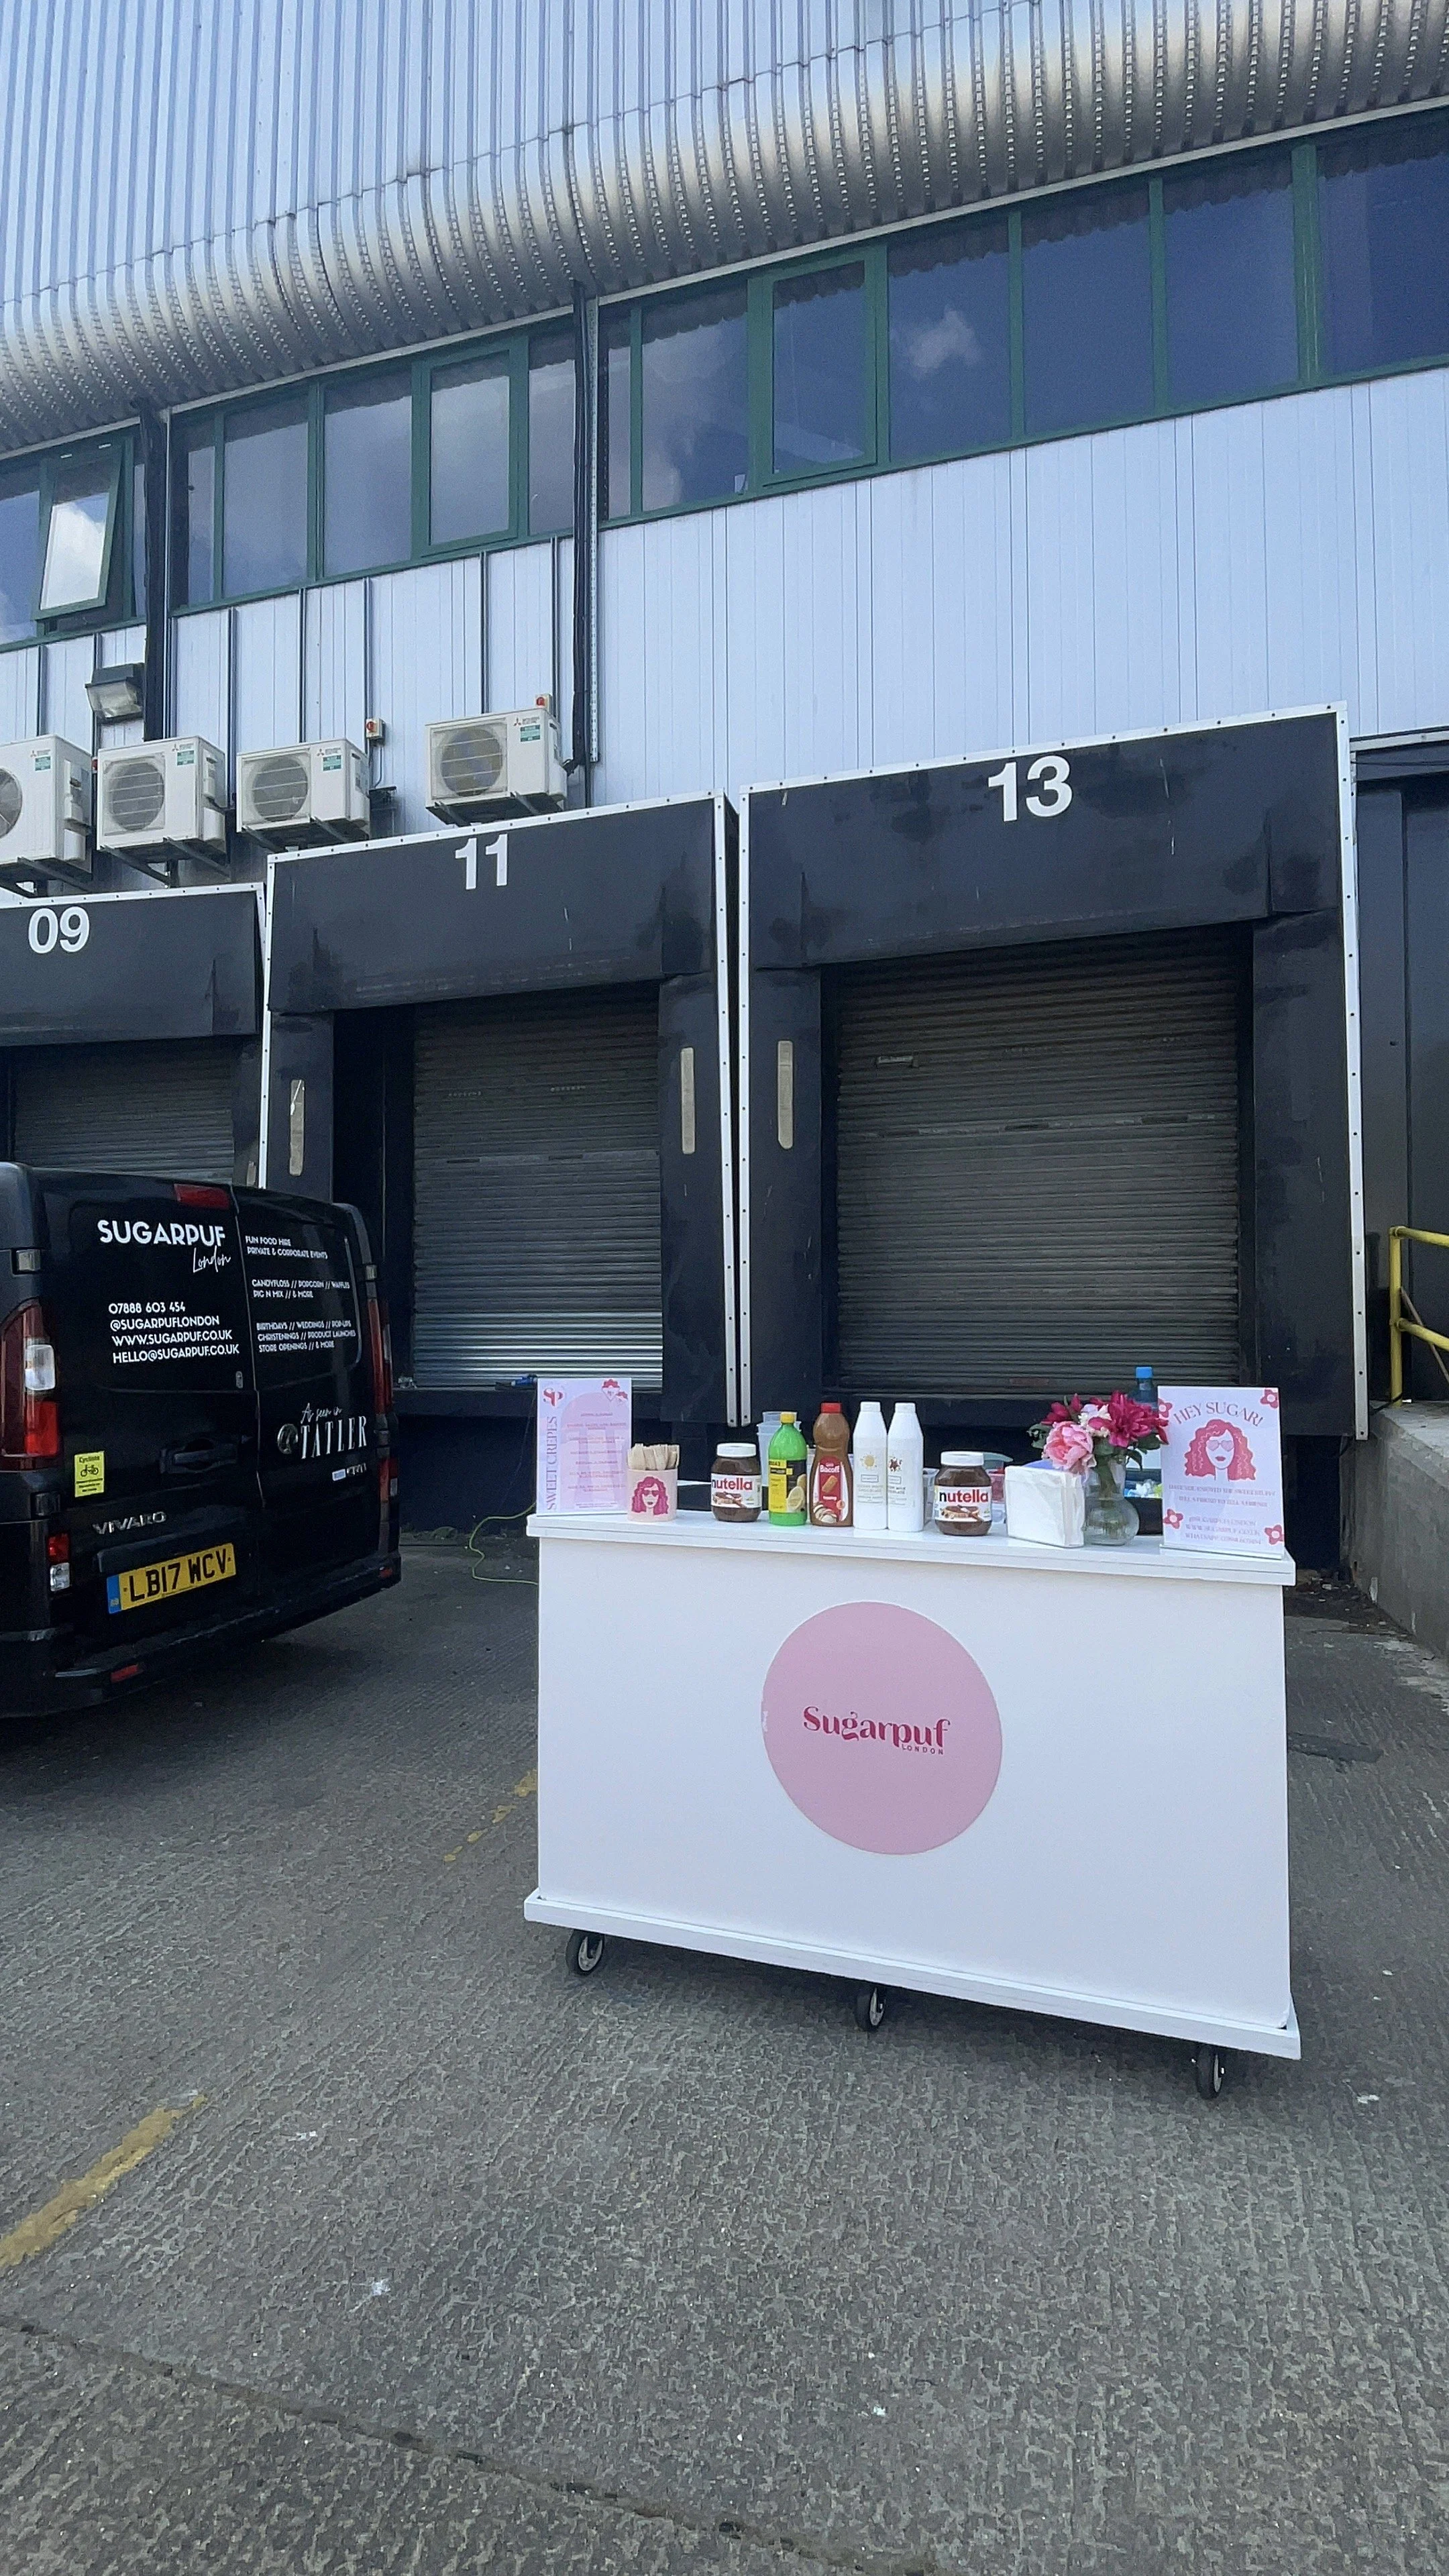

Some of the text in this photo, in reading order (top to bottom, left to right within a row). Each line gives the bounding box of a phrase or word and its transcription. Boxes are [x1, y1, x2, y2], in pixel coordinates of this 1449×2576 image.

[987, 755, 1073, 822] 13
[455, 833, 508, 890] 11
[28, 906, 89, 953] 09
[97, 1220, 225, 1247] SUGARPUF
[245, 1235, 259, 1244] FUN
[260, 1236, 277, 1245] FOOD
[193, 1245, 231, 1273] London
[247, 1246, 270, 1256] PRIVATE
[277, 1248, 309, 1258] CORPORATE
[310, 1250, 328, 1259] EVENTS
[252, 1279, 290, 1288] CANDYFLOSS
[298, 1280, 324, 1289] POPCORN
[266, 1290, 272, 1298] N
[272, 1290, 284, 1298] MIX
[298, 1291, 313, 1299] MORE
[108, 1301, 186, 1315] 07888 603 454
[110, 1316, 220, 1332] @SUGARPUFLONDON
[256, 1322, 288, 1331] BIRTHDAYS
[296, 1321, 325, 1329] WEDDINGS
[111, 1330, 233, 1347] WWW.SUGARPUF.CO.UK
[258, 1332, 299, 1342] CHRISTENINGS
[307, 1330, 332, 1339] PRODUCT
[332, 1330, 356, 1338] LAUNCHES
[113, 1344, 240, 1364] HELLO@SUGARPUF.CO.UK
[258, 1344, 277, 1352] STORE
[278, 1342, 307, 1351] OPENINGS
[320, 1340, 335, 1348] MORE
[1173, 1401, 1264, 1427] HEY SUGAR!
[301, 1415, 367, 1459] TATLER
[546, 1467, 557, 1510] SWEET
[712, 1477, 753, 1490] nutella
[939, 1489, 989, 1503] nutella
[92, 1511, 166, 1535] VIVARO
[129, 1548, 226, 1602] LB17 WCV
[804, 1706, 951, 1748] Sugarpuf
[902, 1743, 943, 1755] LONDON
